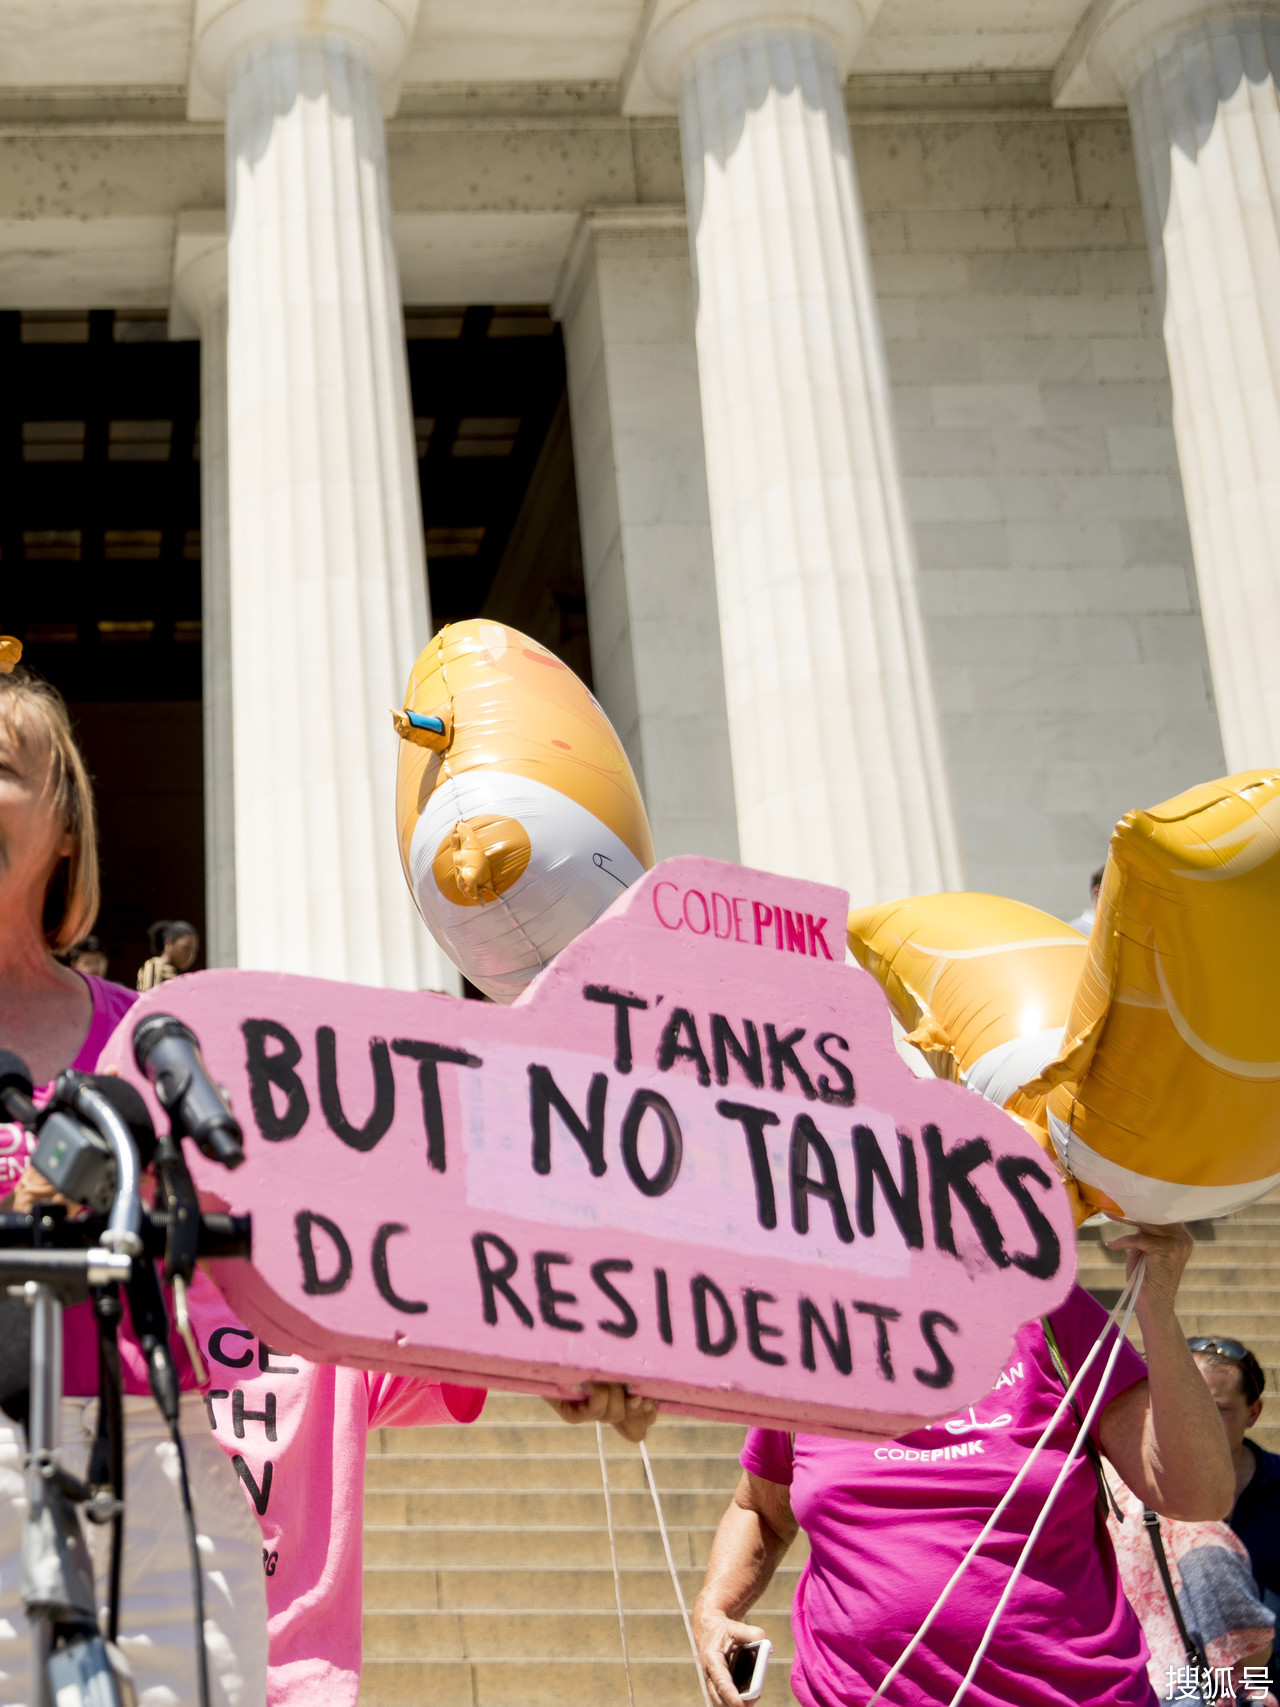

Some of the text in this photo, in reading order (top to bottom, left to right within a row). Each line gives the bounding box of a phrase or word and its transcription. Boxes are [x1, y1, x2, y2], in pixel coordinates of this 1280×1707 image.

[652, 881, 833, 960] CODEPINK
[241, 1017, 1061, 1281] BUT NO TANKS
[293, 1210, 959, 1391] DC RESIDENTS
[873, 1439, 985, 1462] CODEPINK
